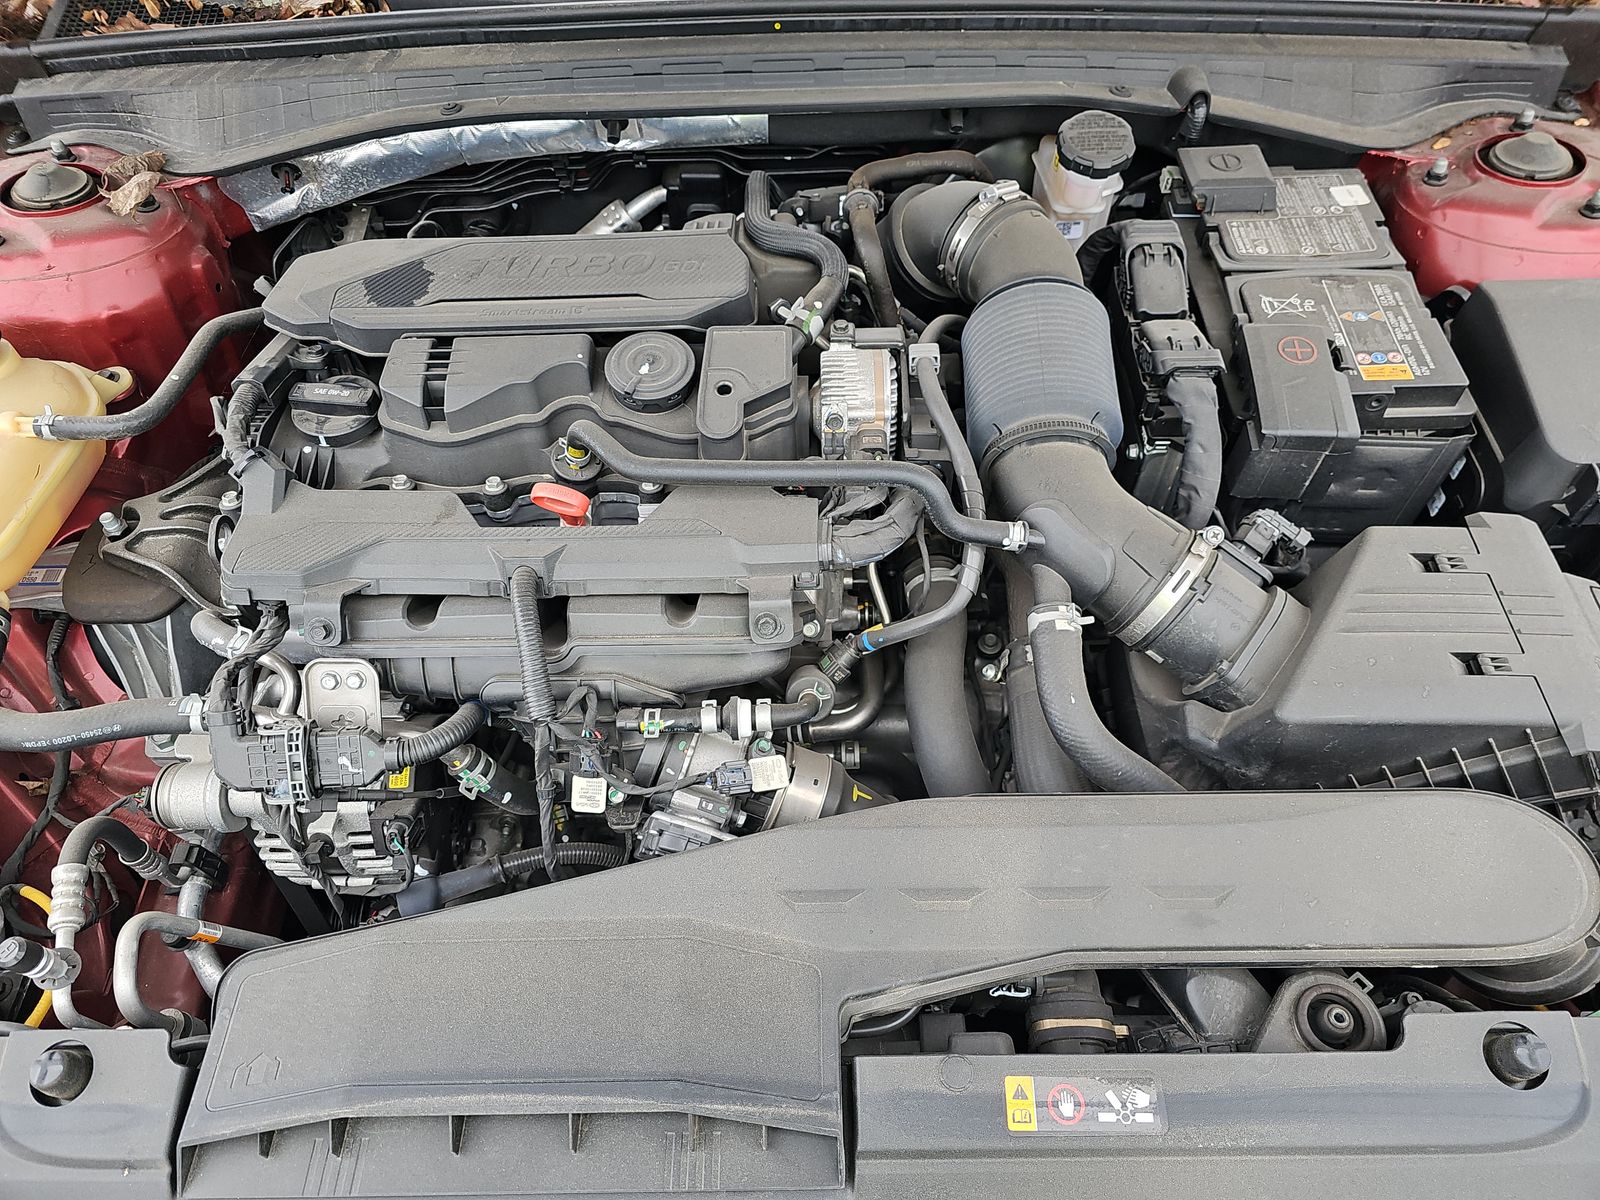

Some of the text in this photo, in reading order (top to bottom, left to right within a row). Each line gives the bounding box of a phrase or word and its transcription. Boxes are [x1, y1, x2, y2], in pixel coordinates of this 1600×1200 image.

[469, 253, 657, 279] TURBO
[1302, 298, 1317, 312] Pb
[479, 307, 567, 318] Smartstream
[313, 387, 351, 397] SAE 0W-20
[53, 728, 102, 746] 25450-L0200
